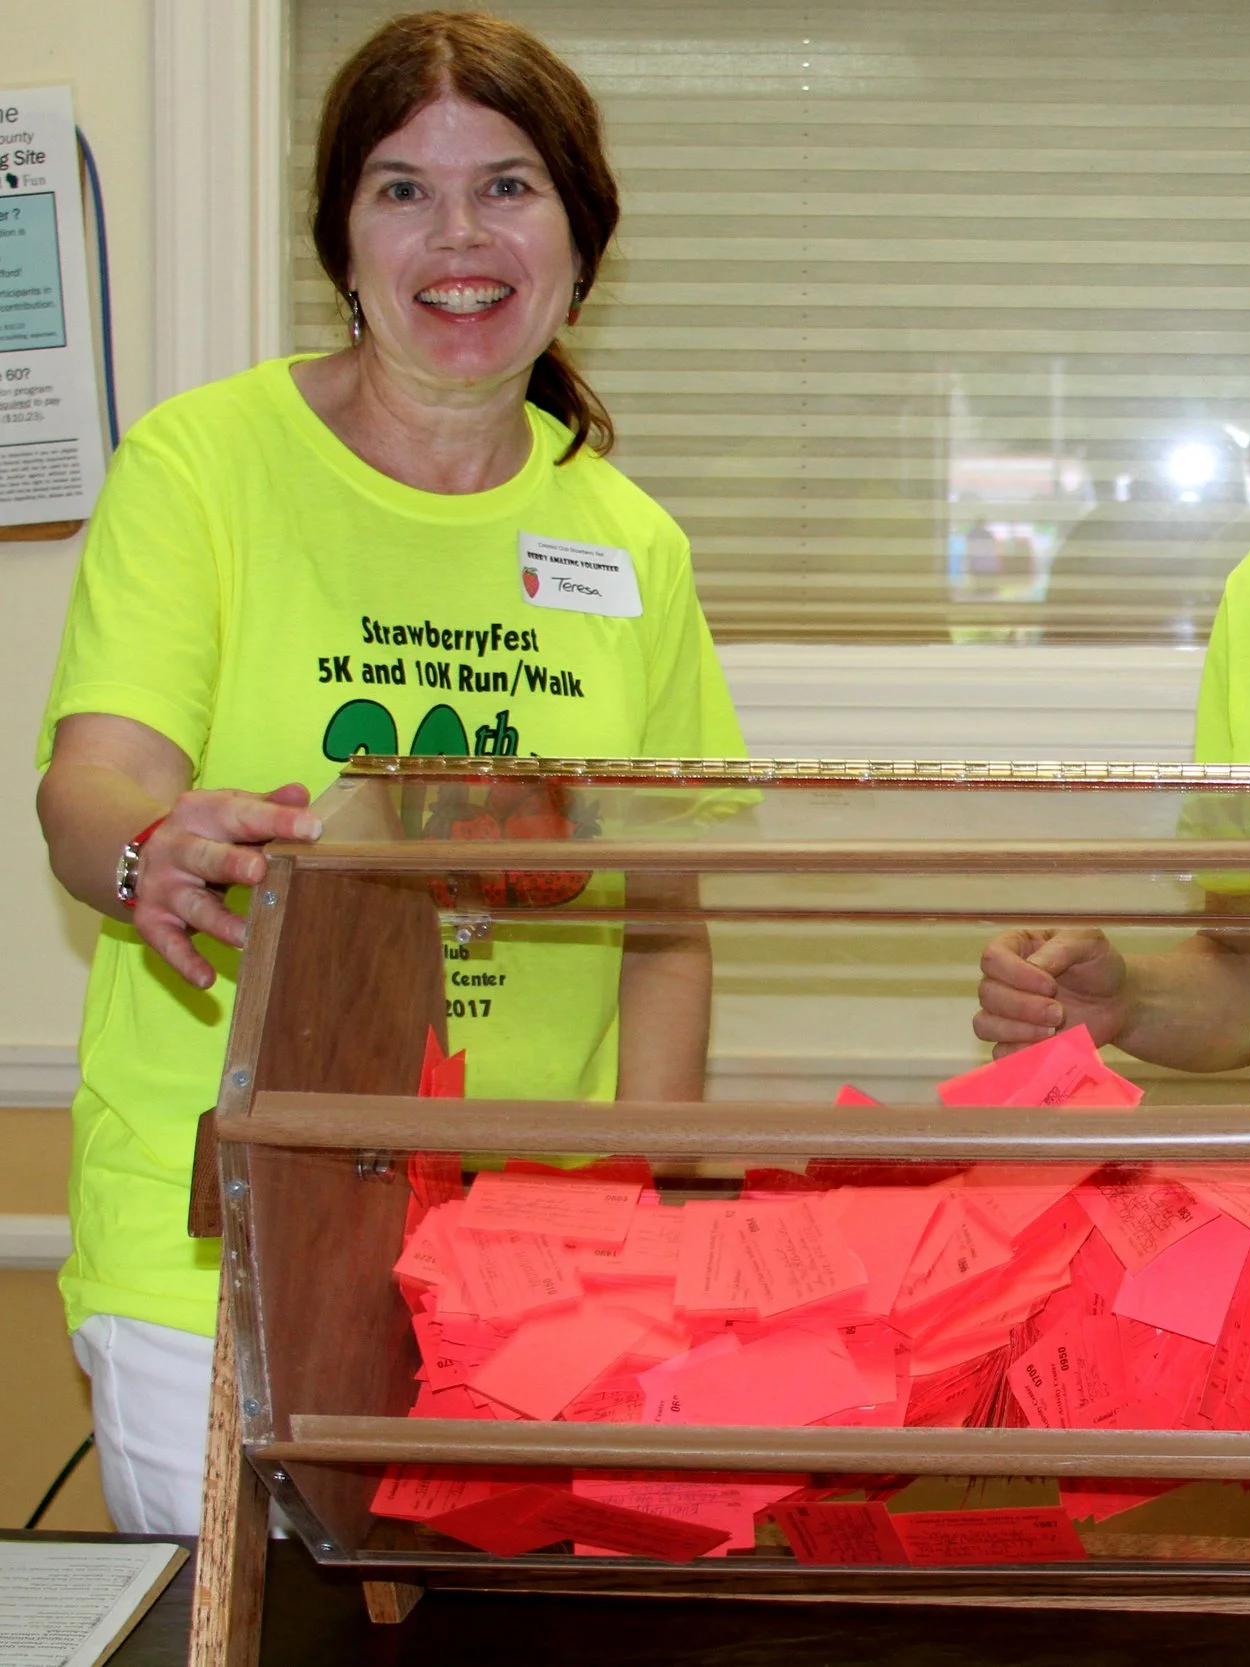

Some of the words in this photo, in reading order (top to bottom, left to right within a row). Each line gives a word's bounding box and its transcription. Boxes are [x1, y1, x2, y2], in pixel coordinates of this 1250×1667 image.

[13, 149, 46, 166] Site
[6, 367, 31, 382] 60?
[580, 561, 620, 573] VOLUNTEER
[551, 576, 603, 597] Teresa
[361, 616, 540, 658] StrawberryFest
[318, 655, 353, 684] 5K
[361, 657, 406, 686] and
[415, 660, 452, 691] 10K
[458, 659, 585, 698] Run/Walk
[443, 943, 470, 960] lub
[451, 971, 507, 987] Center
[1057, 1345, 1070, 1372] 0950
[1025, 1363, 1043, 1389] 0709
